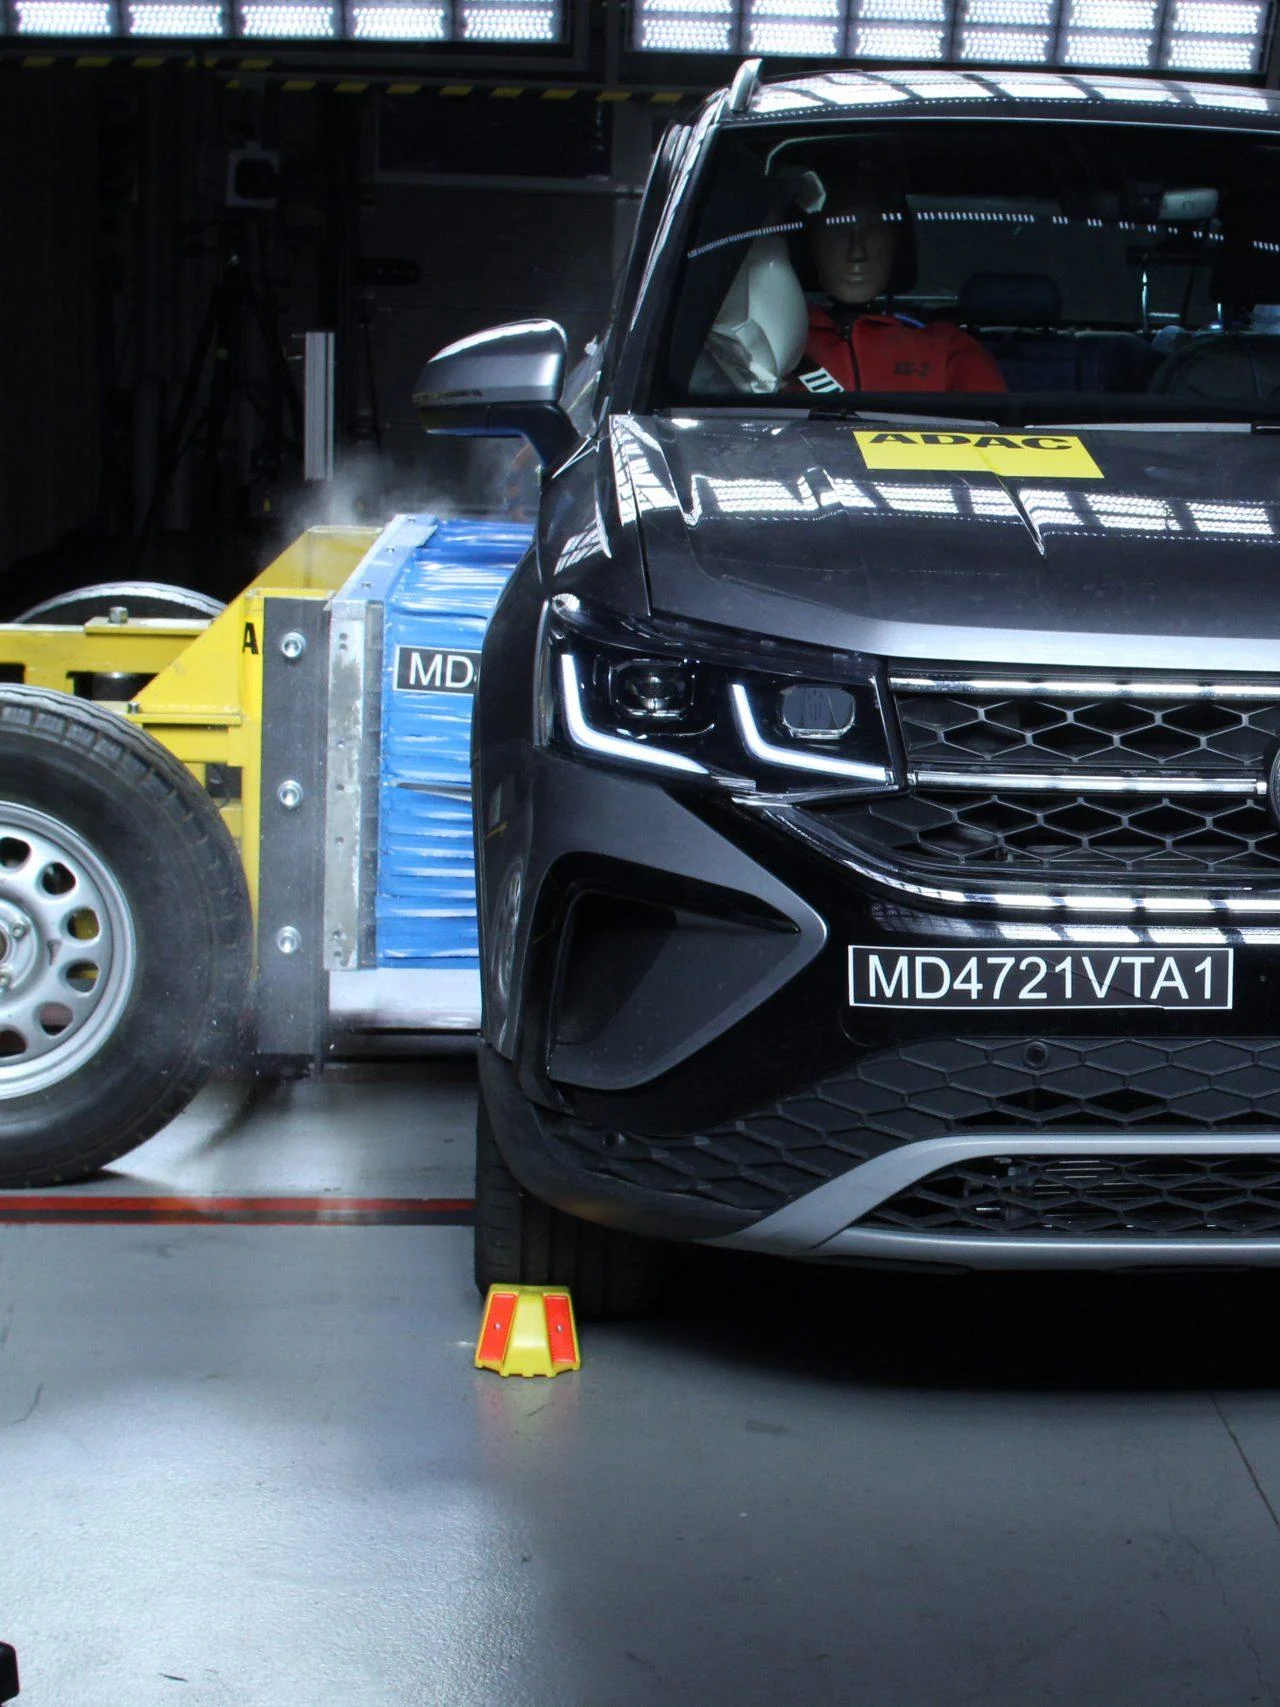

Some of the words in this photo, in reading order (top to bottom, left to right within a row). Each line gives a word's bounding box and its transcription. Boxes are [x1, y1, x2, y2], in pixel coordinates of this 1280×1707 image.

[869, 433, 1073, 450] ADAC
[242, 622, 259, 655] A
[409, 652, 477, 688] MD
[868, 955, 1213, 1000] MD4721VTA1
